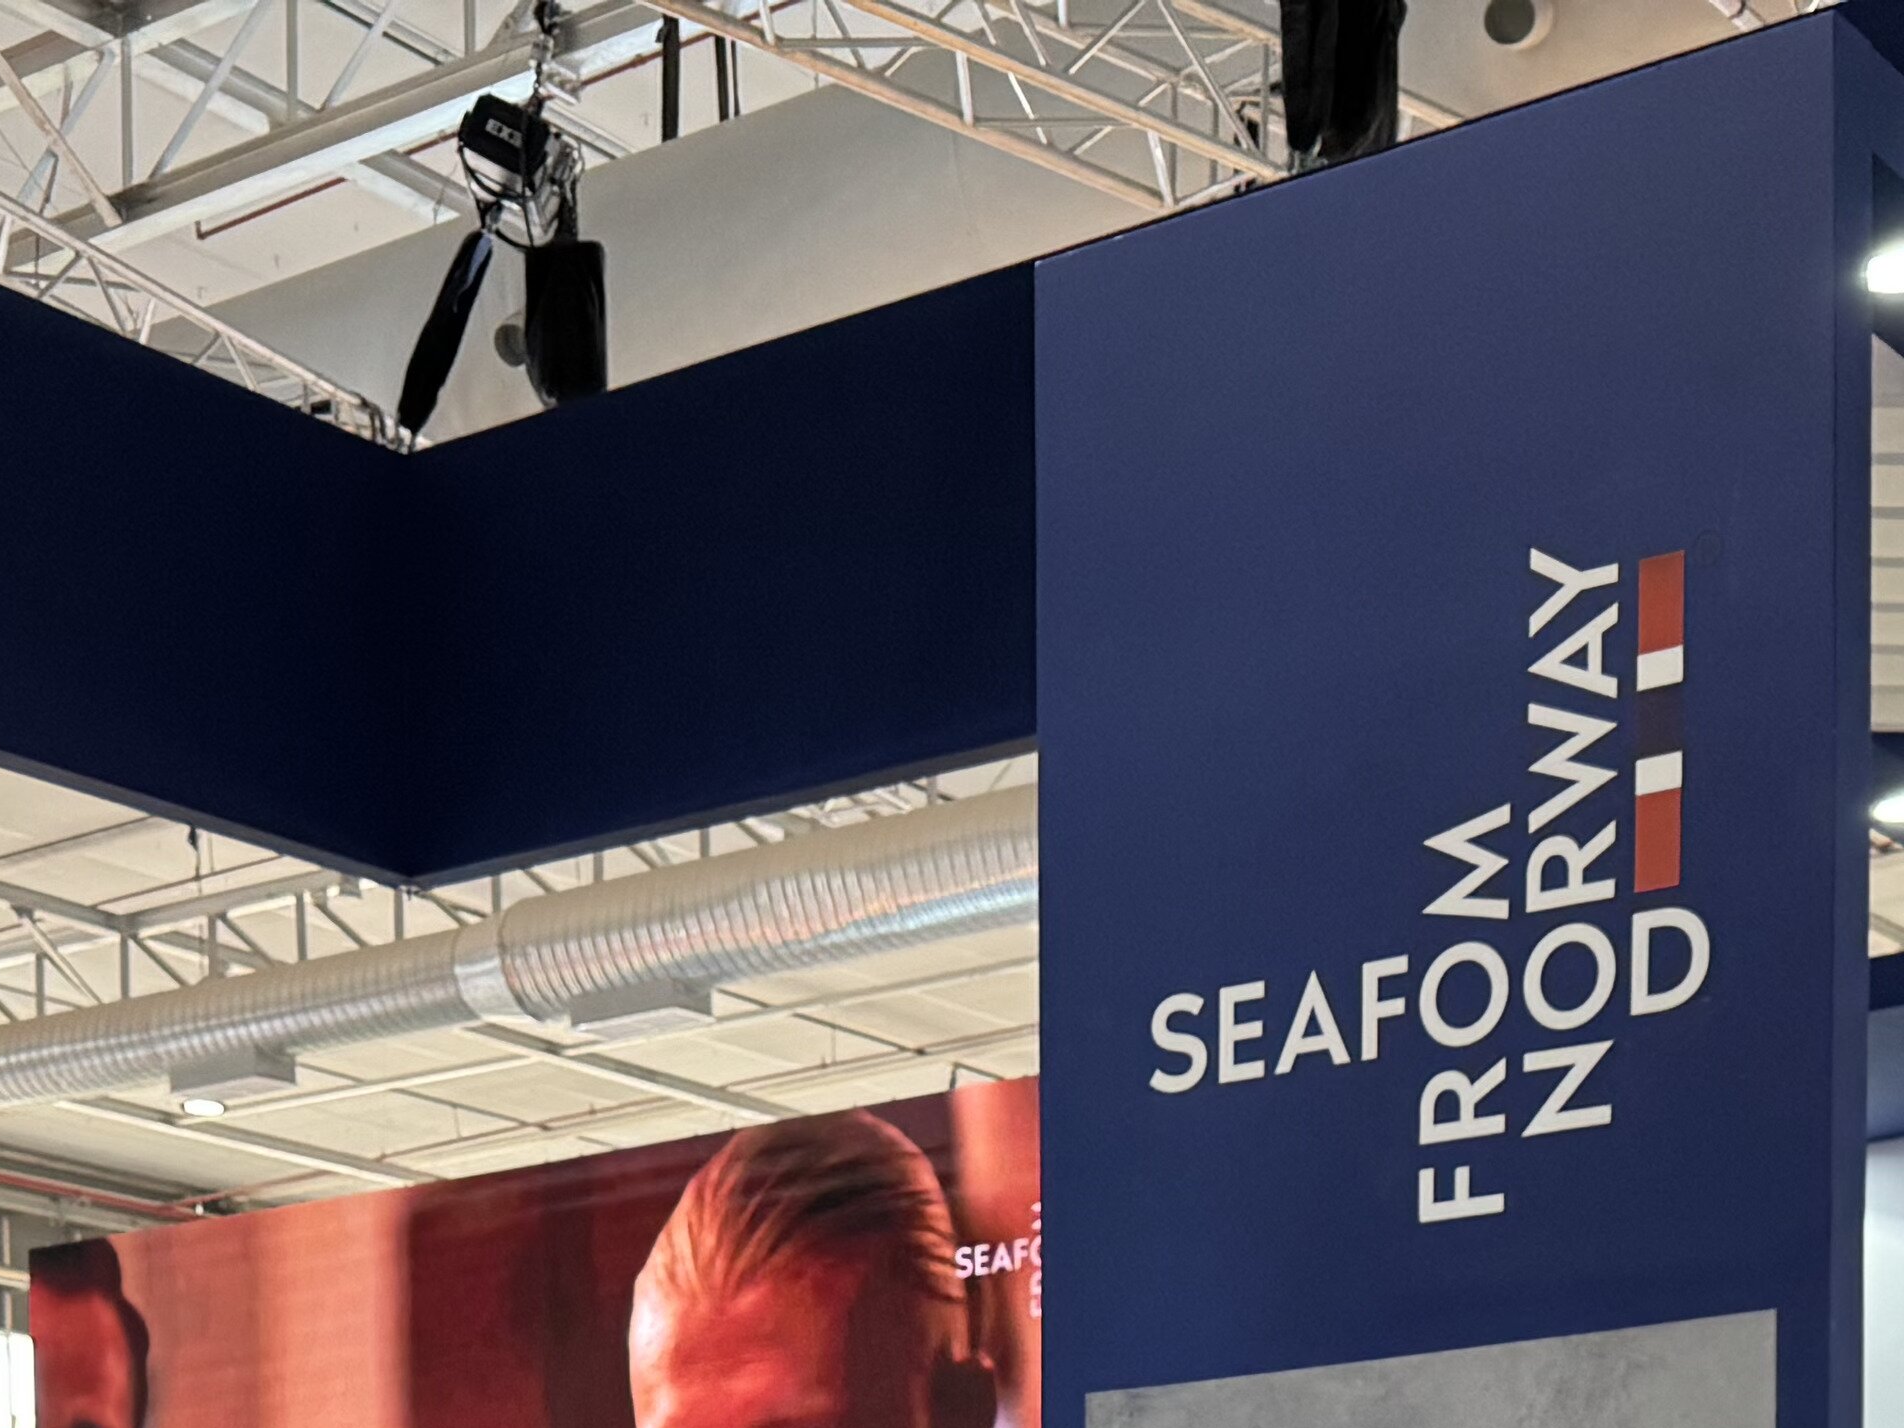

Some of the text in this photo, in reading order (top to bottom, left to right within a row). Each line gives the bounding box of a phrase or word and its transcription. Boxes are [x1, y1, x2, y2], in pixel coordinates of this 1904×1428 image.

[1148, 907, 1712, 1094] SEAFOOD
[1417, 802, 1512, 1224] FROM
[1523, 546, 1620, 1138] NORWAY
